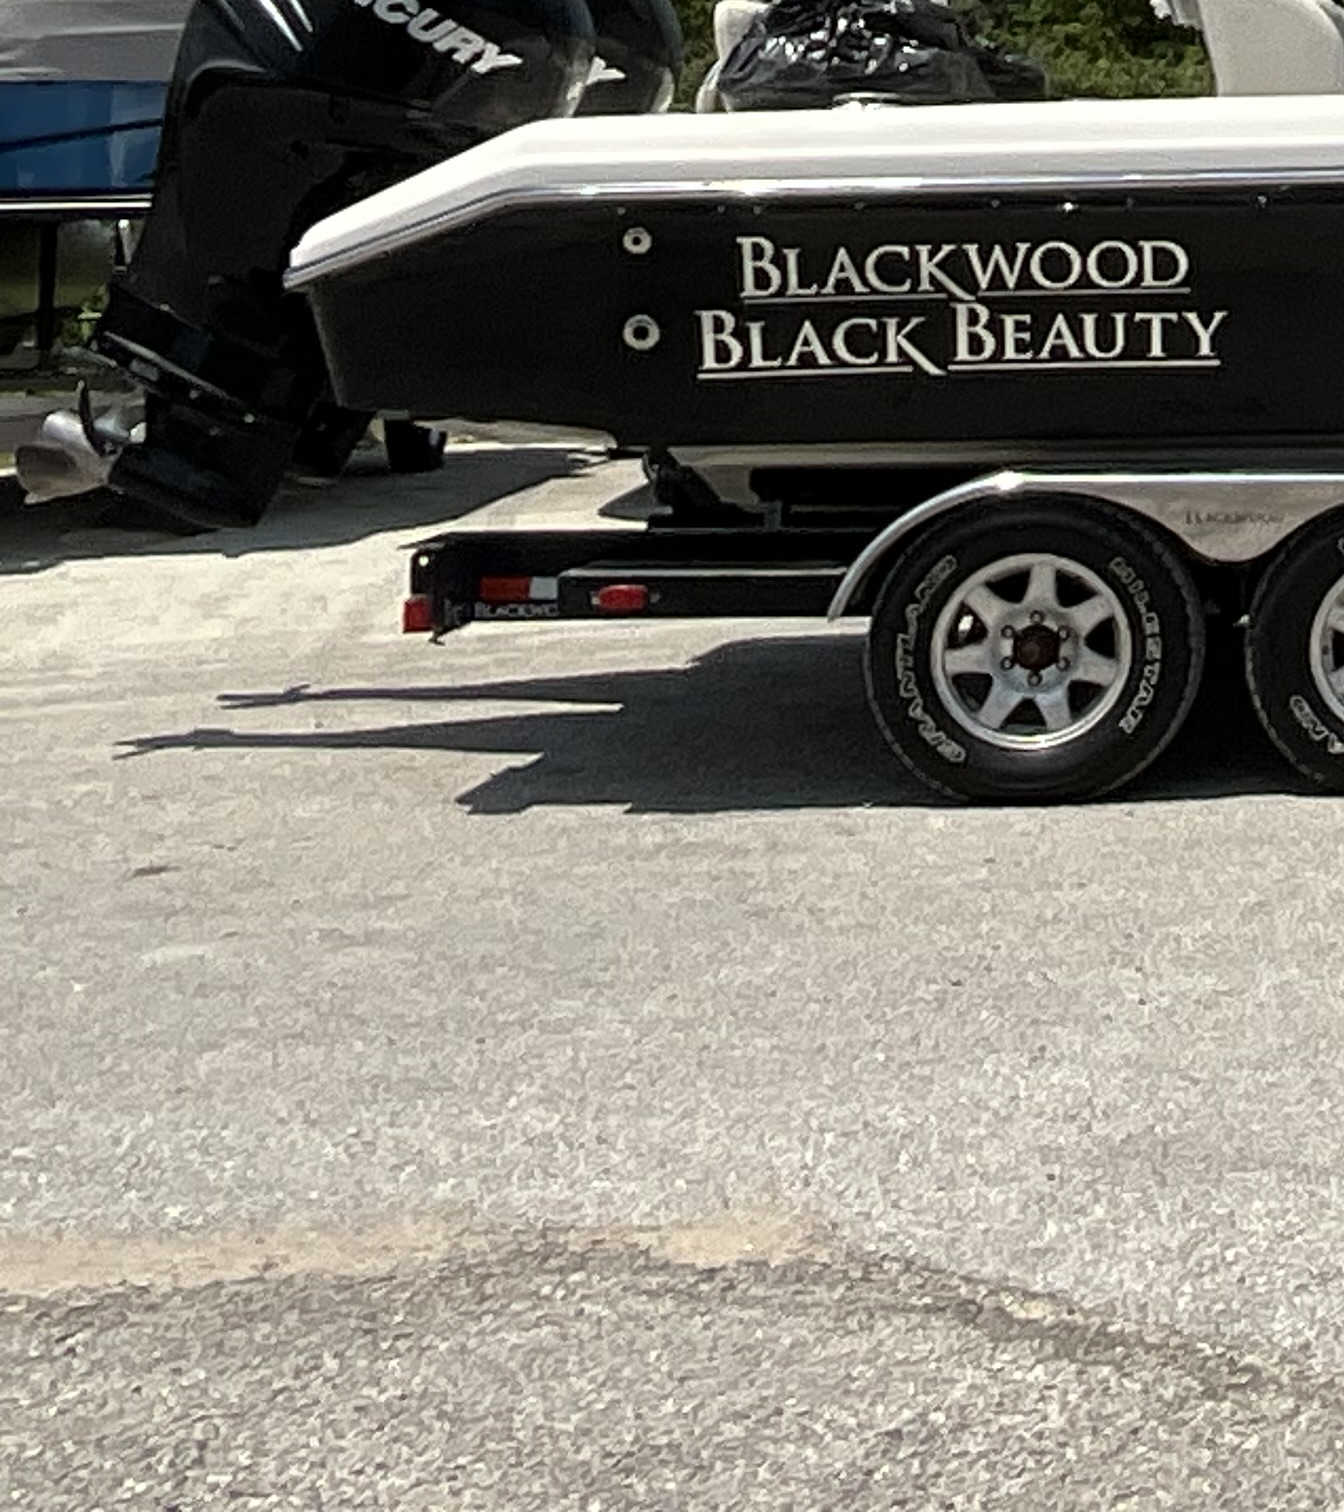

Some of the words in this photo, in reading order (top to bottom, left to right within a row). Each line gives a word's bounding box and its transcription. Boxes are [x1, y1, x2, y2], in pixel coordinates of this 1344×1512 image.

[736, 235, 1190, 300] BLACKWOOD
[694, 309, 947, 376] BLACK
[949, 302, 1228, 364] BEAUTY
